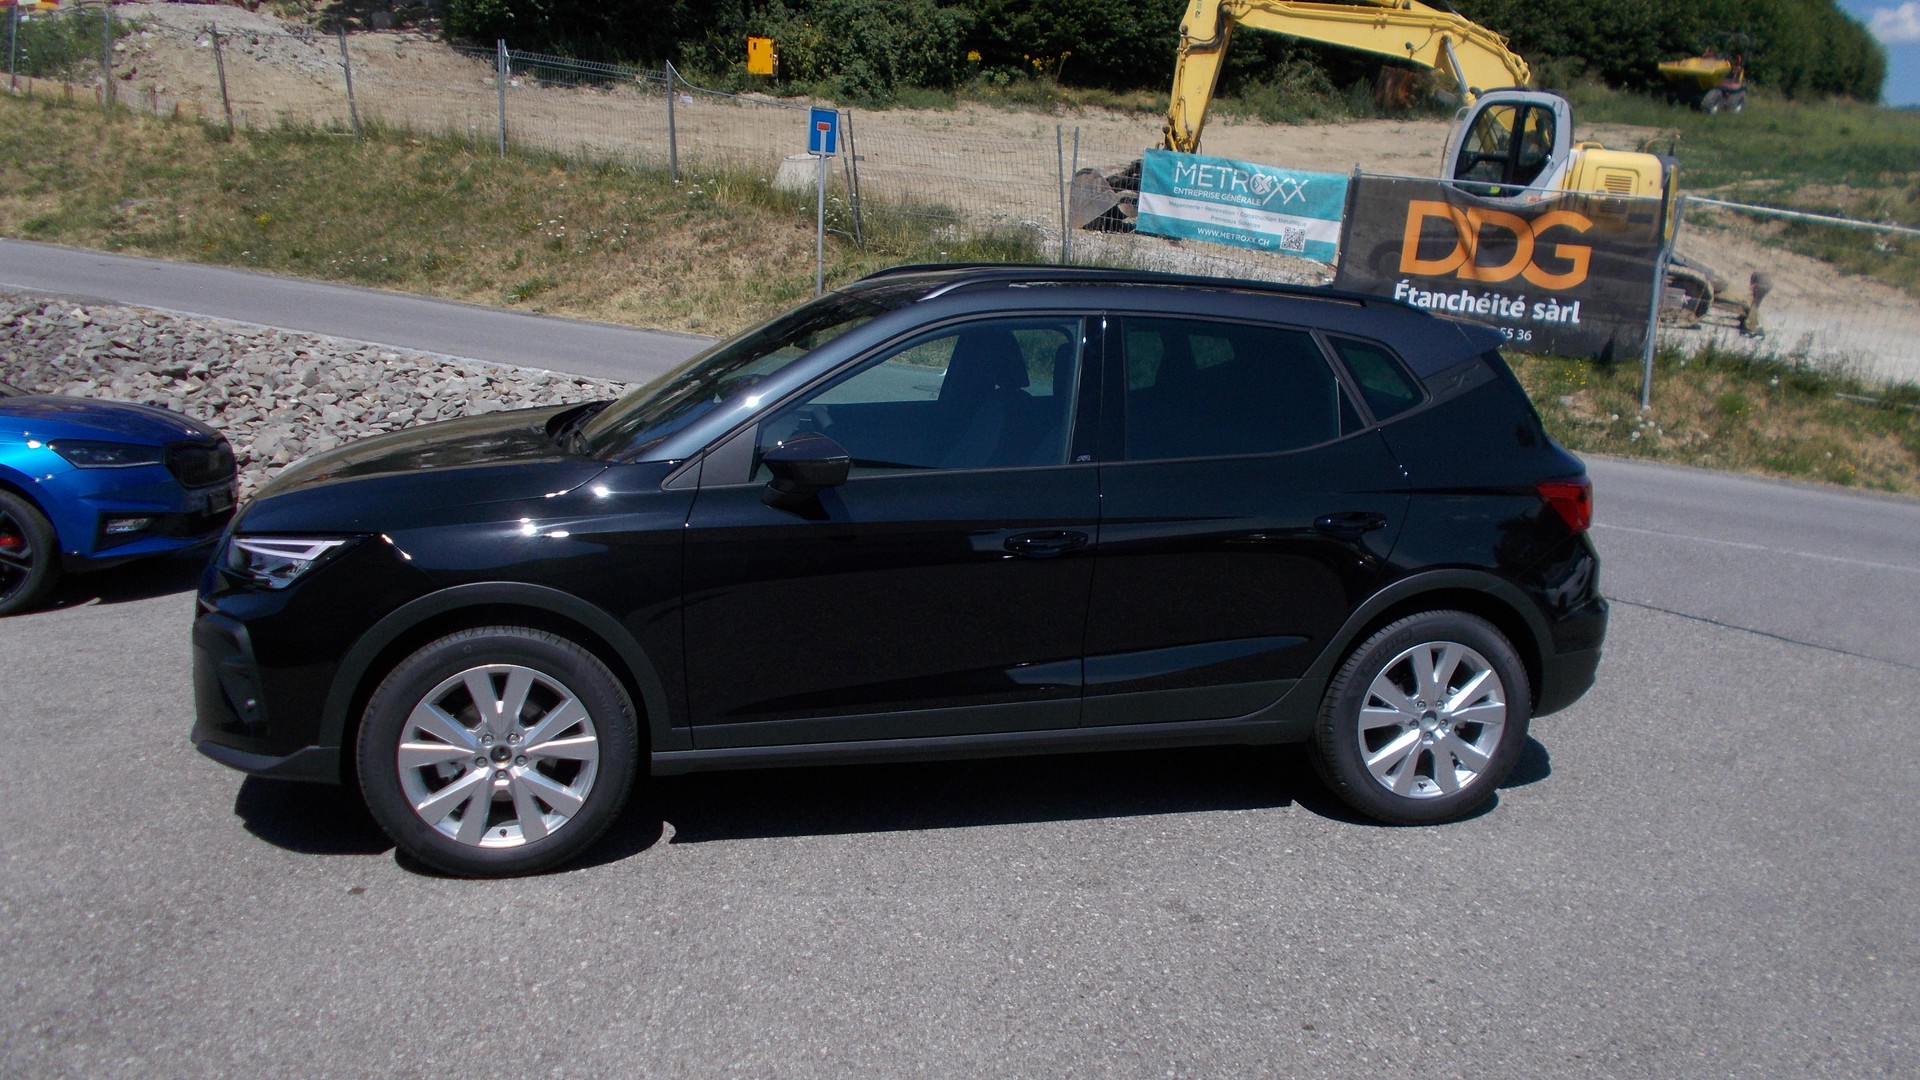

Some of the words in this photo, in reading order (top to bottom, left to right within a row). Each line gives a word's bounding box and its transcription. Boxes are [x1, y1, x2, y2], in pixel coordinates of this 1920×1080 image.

[1173, 186, 1220, 200] ENTREPRISE
[1221, 191, 1262, 206] GÉNÉRALE
[1197, 227, 1271, 247] WWW.METROXX.CH
[1400, 200, 1594, 290] DDG
[1394, 279, 1526, 318] Étanchéité
[1532, 298, 1580, 324] sàrl
[1516, 329, 1532, 341] 36
